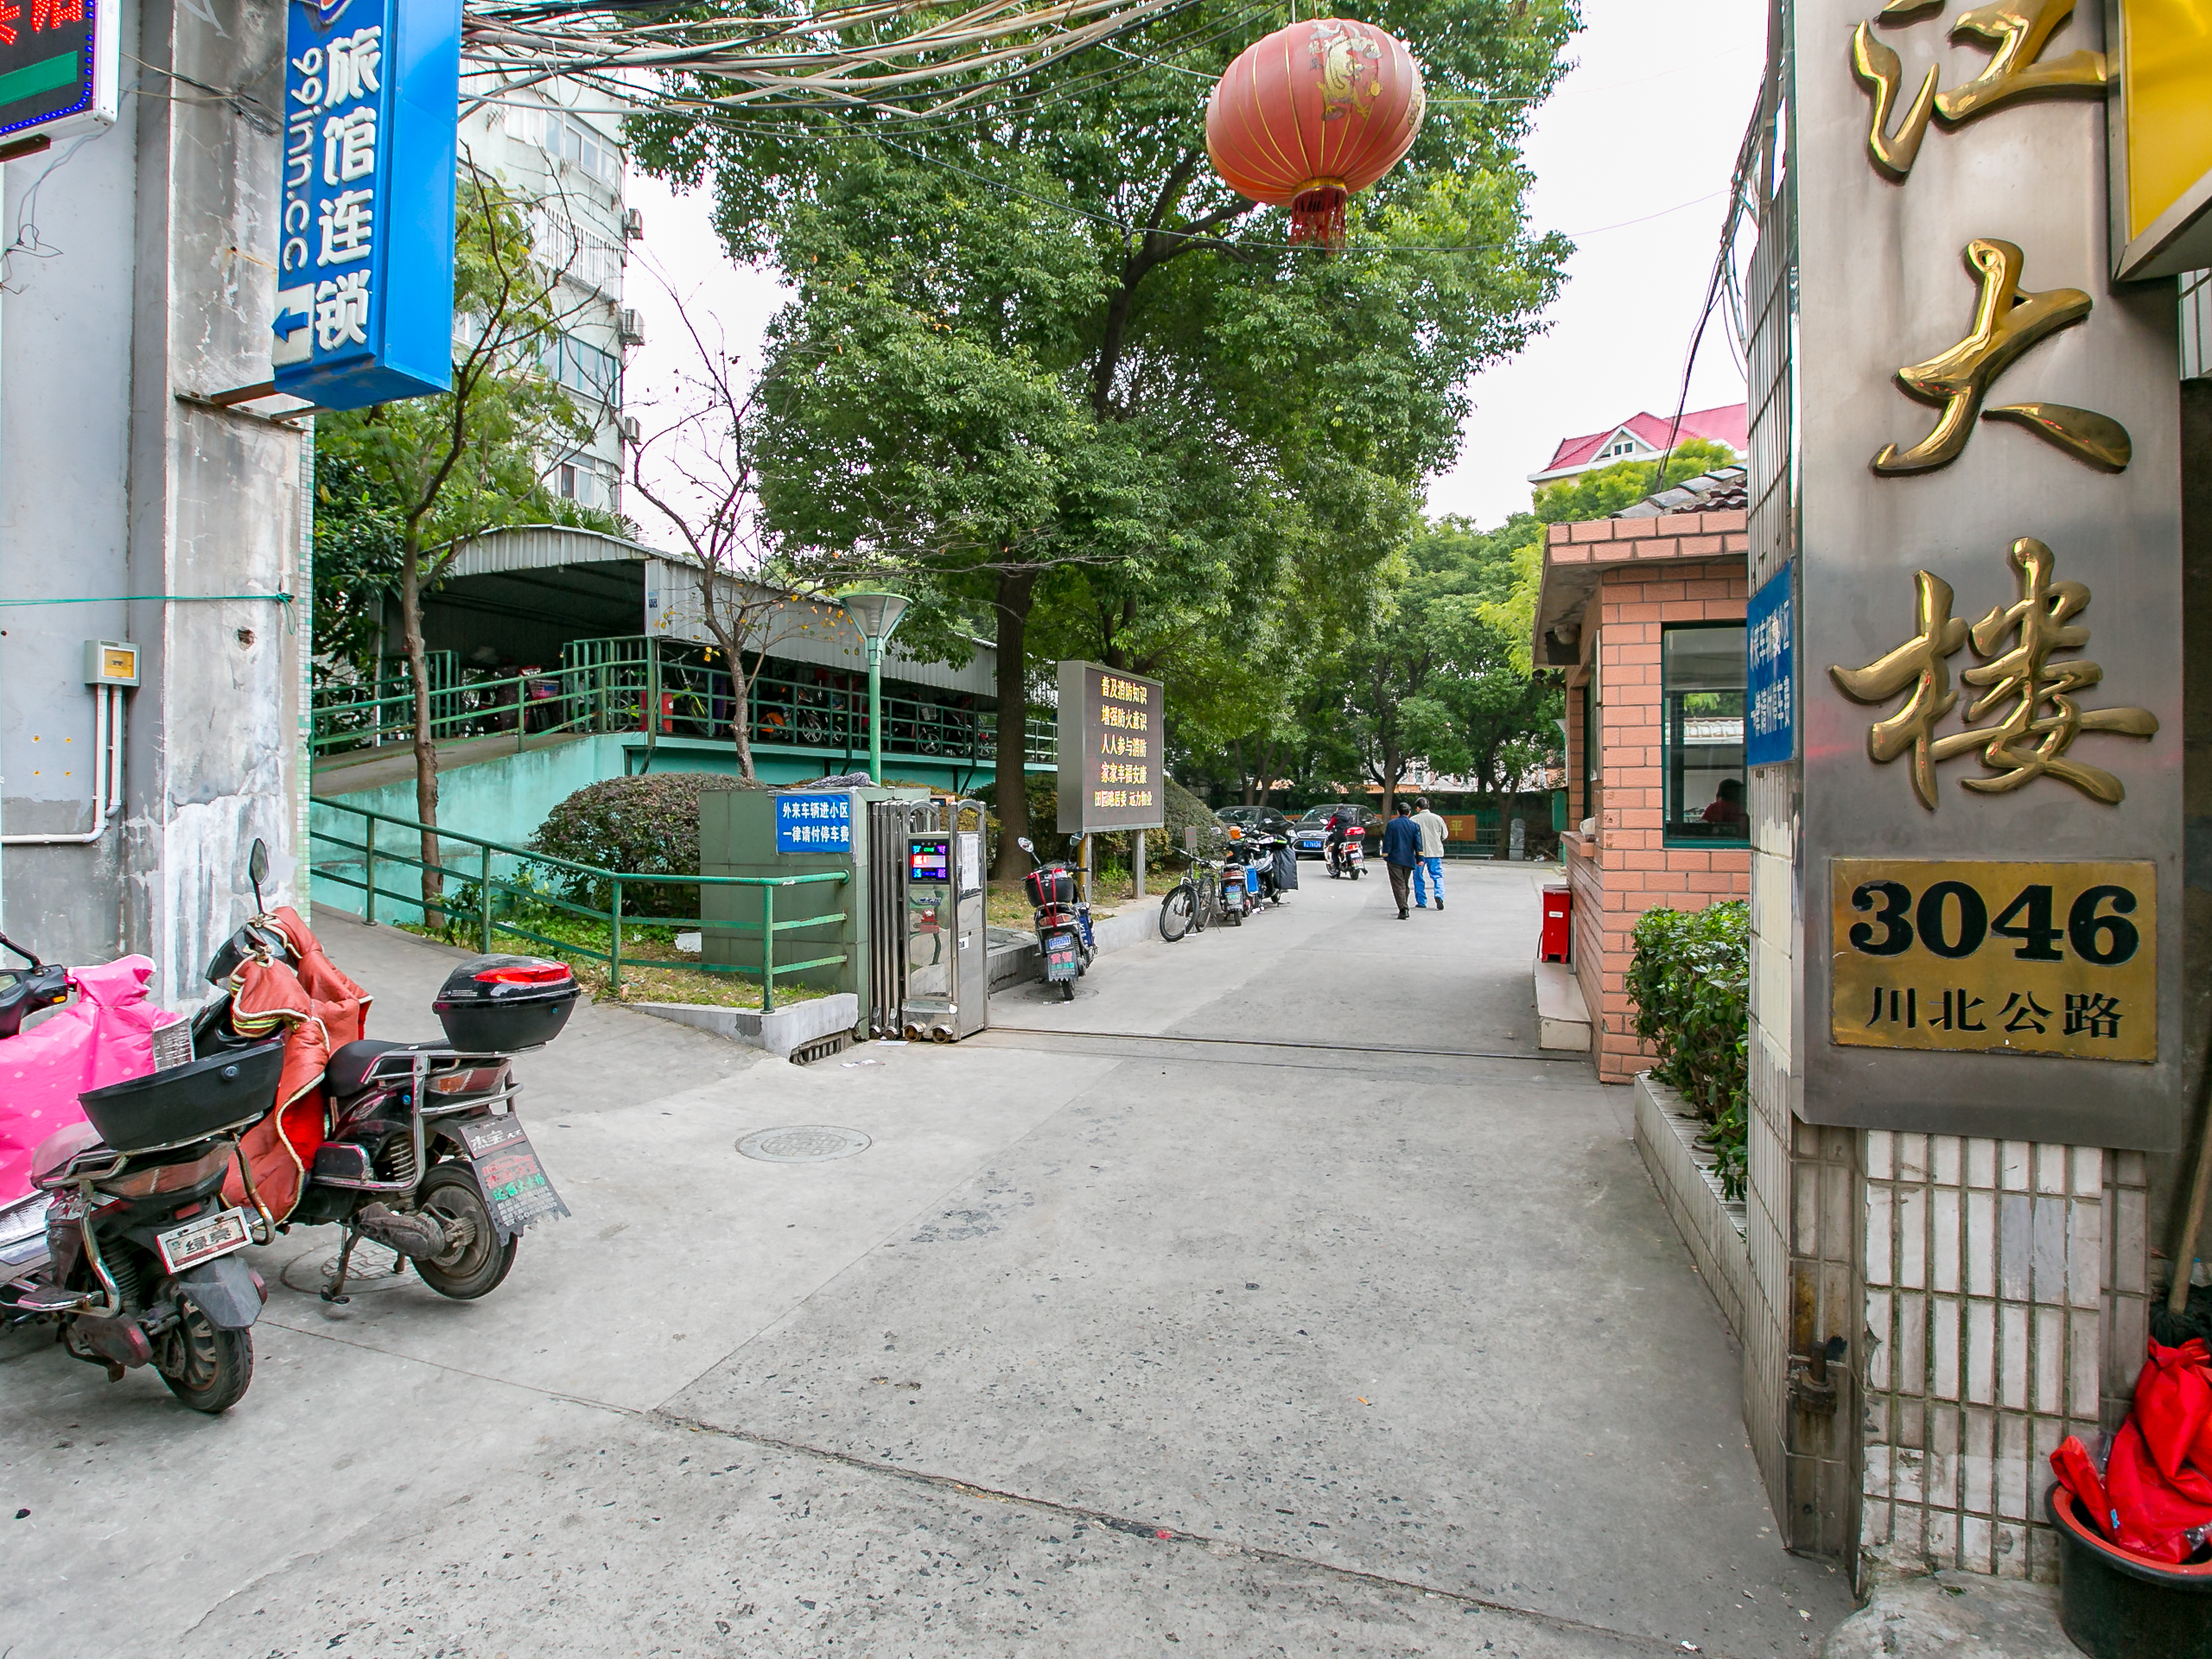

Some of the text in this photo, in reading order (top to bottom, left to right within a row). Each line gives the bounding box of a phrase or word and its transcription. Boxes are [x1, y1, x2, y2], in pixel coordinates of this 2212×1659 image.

[315, 25, 382, 352] 旅馆连锁
[1101, 676, 1147, 705] 普及消防知识
[1101, 704, 1147, 732] 增强防火意识
[1101, 733, 1147, 758] 人人参与消防
[1100, 761, 1147, 785] 家家幸福安康
[783, 802, 849, 820] 外来车辆进小区
[783, 825, 849, 843] 一律请付停车费
[1848, 880, 2140, 967] 3046
[1866, 986, 2124, 1039] 川北公路
